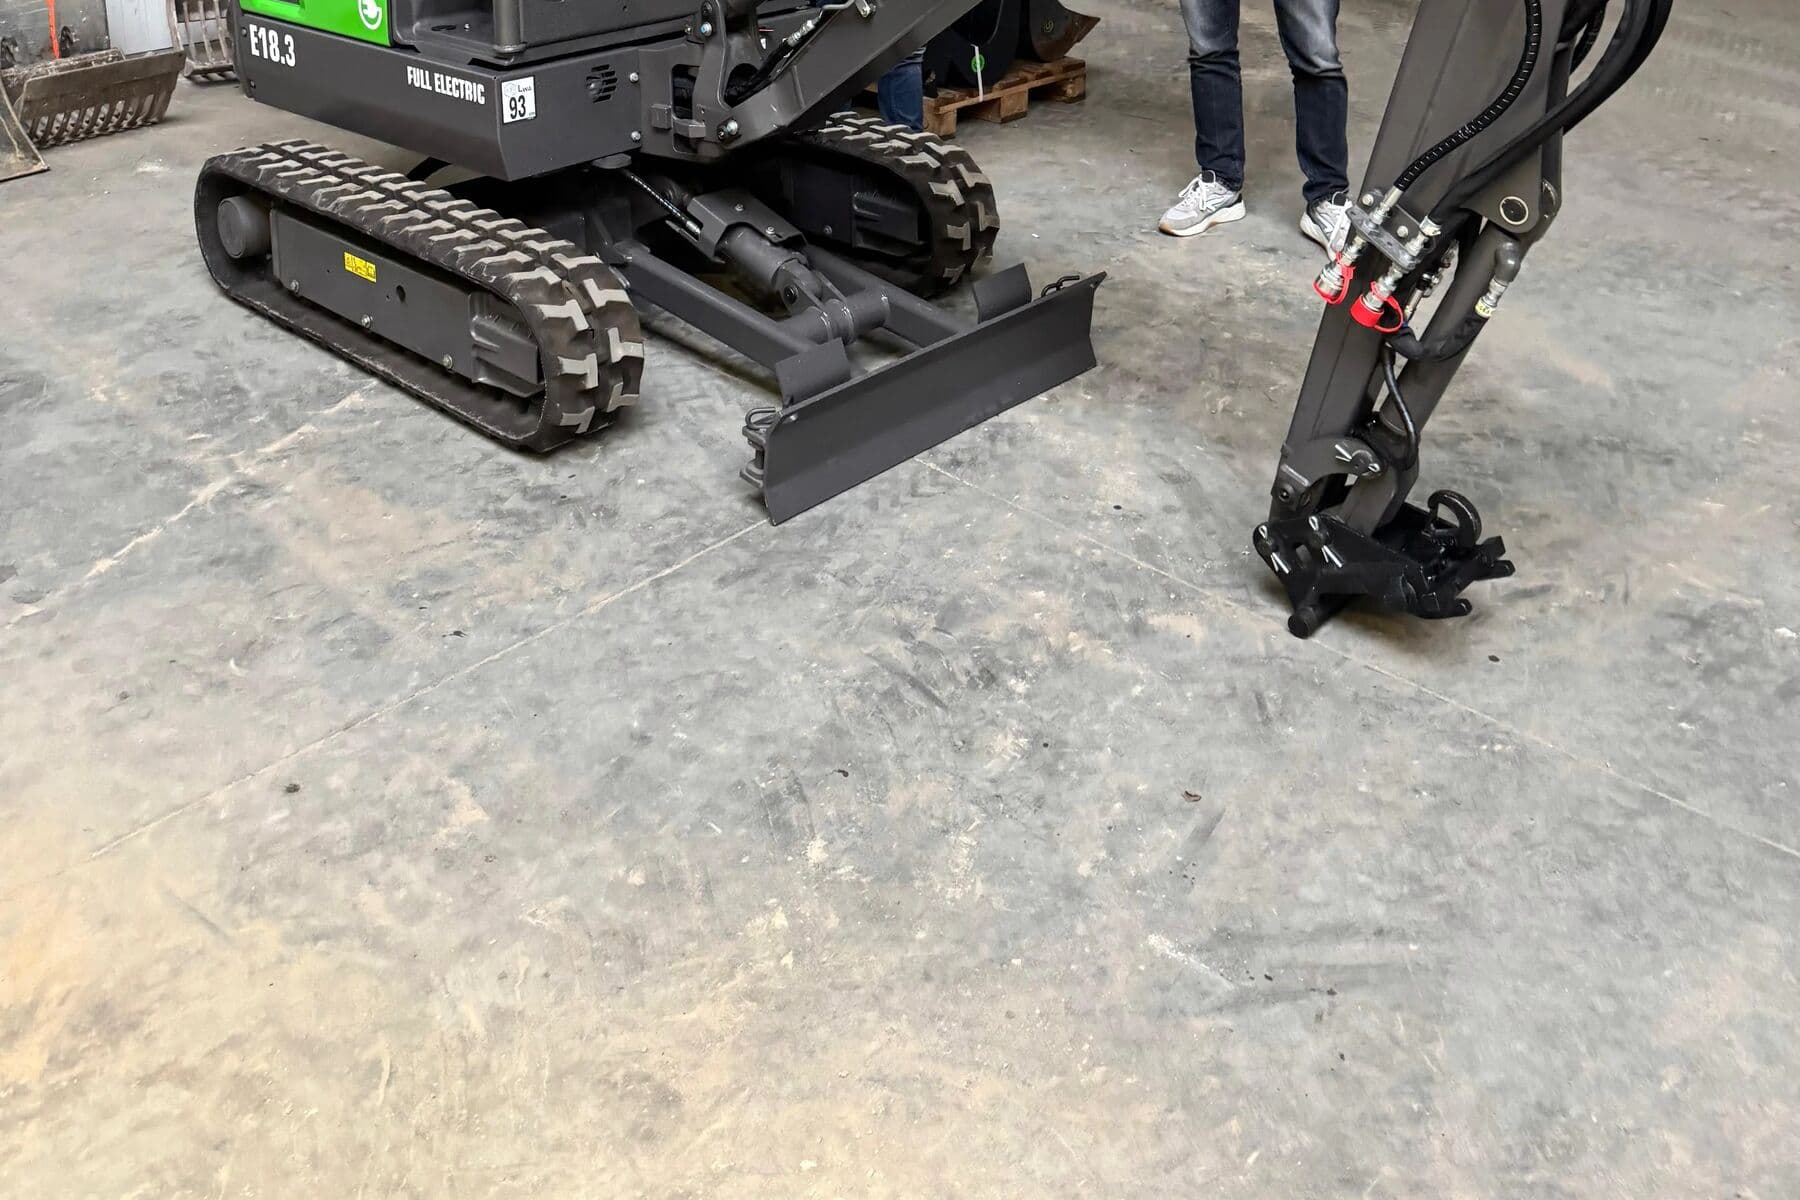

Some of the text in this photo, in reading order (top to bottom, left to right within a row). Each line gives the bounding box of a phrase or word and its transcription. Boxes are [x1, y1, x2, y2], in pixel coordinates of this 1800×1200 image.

[249, 23, 296, 67] E18.3
[406, 65, 486, 105] FULL ELECTRIC
[509, 94, 527, 120] 93
